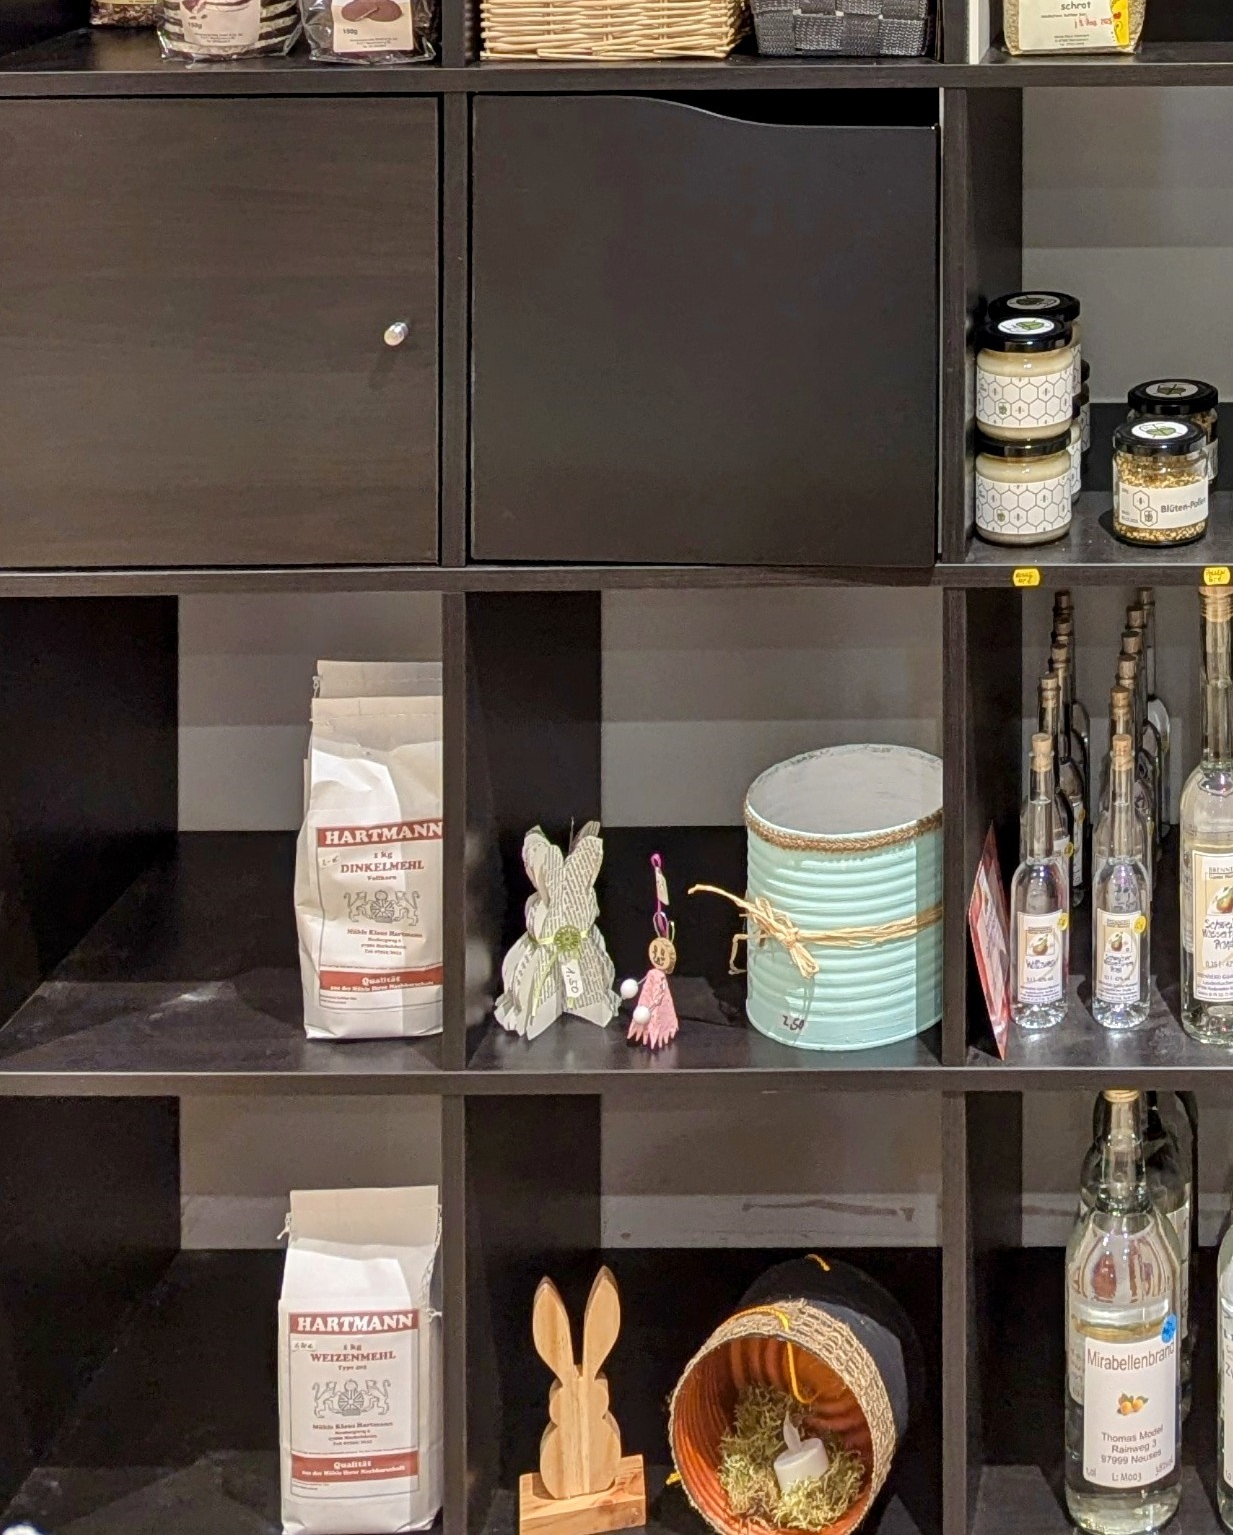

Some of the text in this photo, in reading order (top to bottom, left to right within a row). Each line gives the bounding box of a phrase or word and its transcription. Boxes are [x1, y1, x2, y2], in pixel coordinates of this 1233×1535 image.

[1061, 1, 1091, 10] schrot
[325, 821, 442, 845] HARTMANN
[381, 851, 392, 860] kg
[340, 860, 424, 873] DINKELMEHL
[362, 976, 400, 986] Qualität
[297, 1314, 413, 1332] HARTMANN
[350, 1344, 362, 1352] kg
[310, 1351, 396, 1362] WEIZENMEHL
[1087, 1342, 1175, 1371] Mirabellenbrand
[1102, 1425, 1163, 1444] Thomas Model
[1112, 1439, 1157, 1455] Rainweg 3
[1101, 1449, 1161, 1465] 97999 Neuses
[334, 1461, 372, 1469] Qualität
